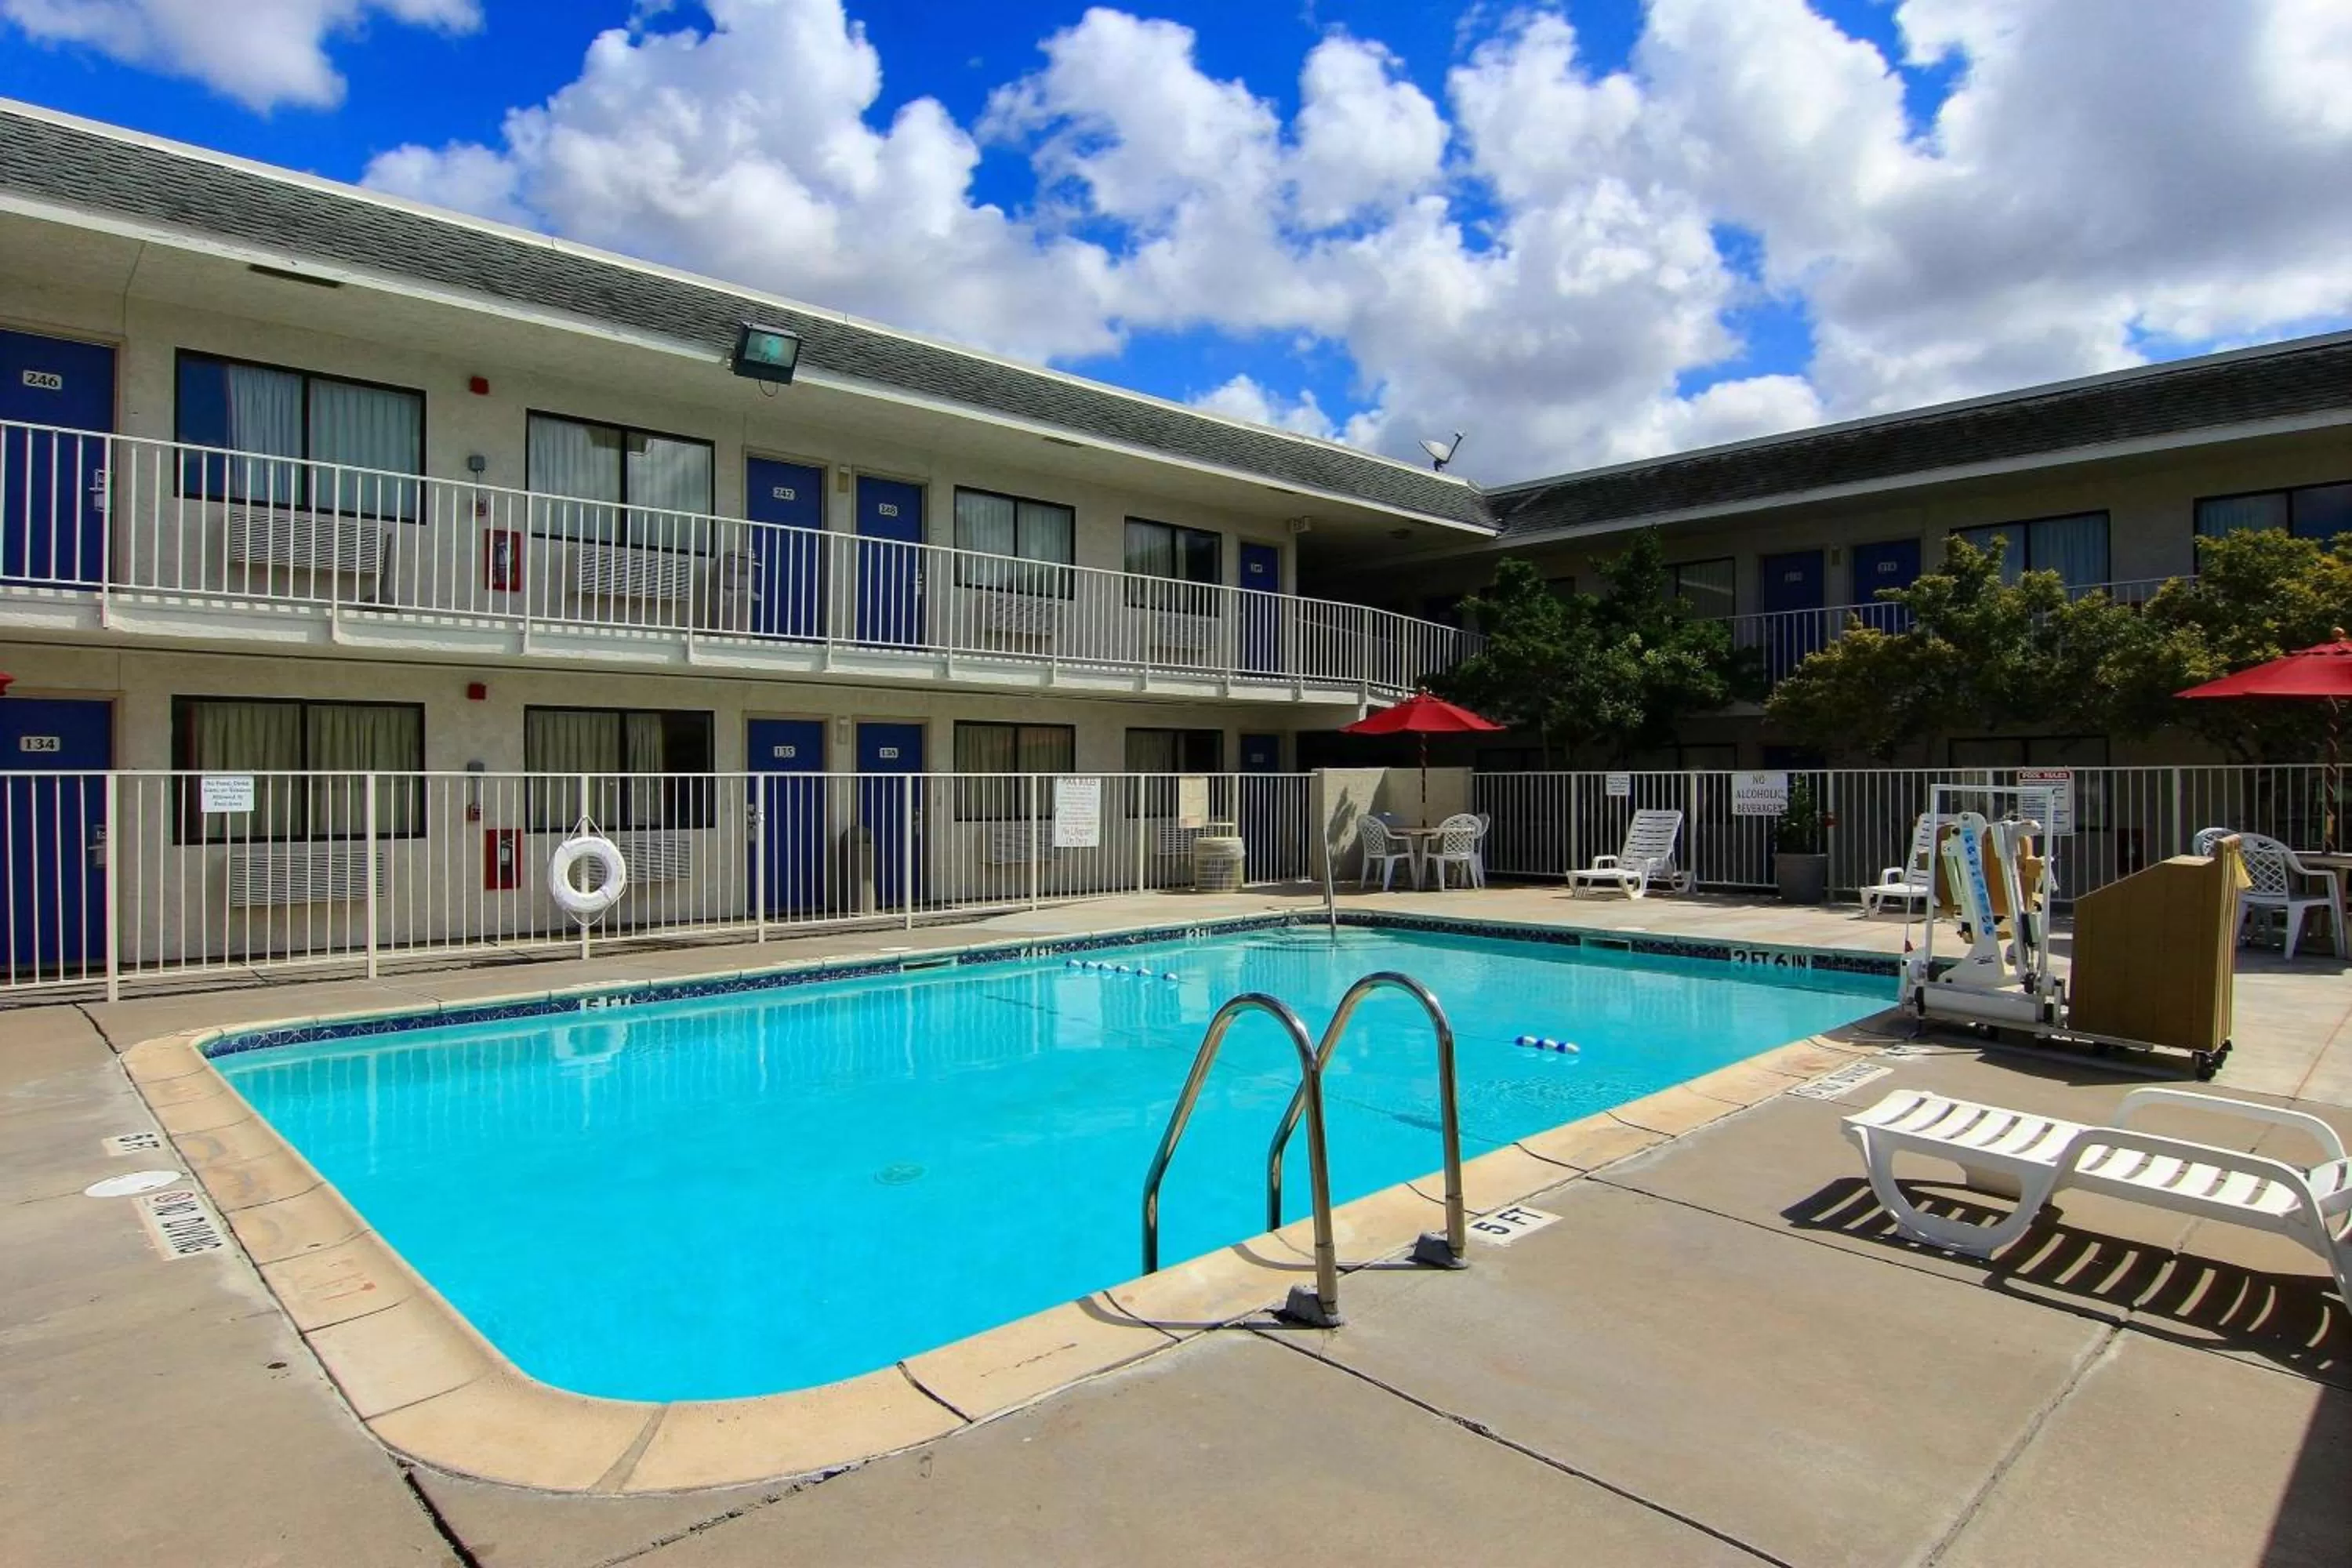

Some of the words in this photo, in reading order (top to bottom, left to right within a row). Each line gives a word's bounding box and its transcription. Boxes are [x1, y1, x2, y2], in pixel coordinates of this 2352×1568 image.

[27, 372, 59, 388] 246
[26, 738, 55, 750] 134
[775, 746, 793, 757] 135
[1752, 774, 1766, 785] NO
[1735, 789, 1784, 799] ALCOHOLIC
[1751, 951, 1769, 965] FT
[152, 1200, 198, 1217] NO
[1471, 1221, 1511, 1235] 5
[1497, 1207, 1543, 1225] FT
[162, 1216, 223, 1254] DIVING
